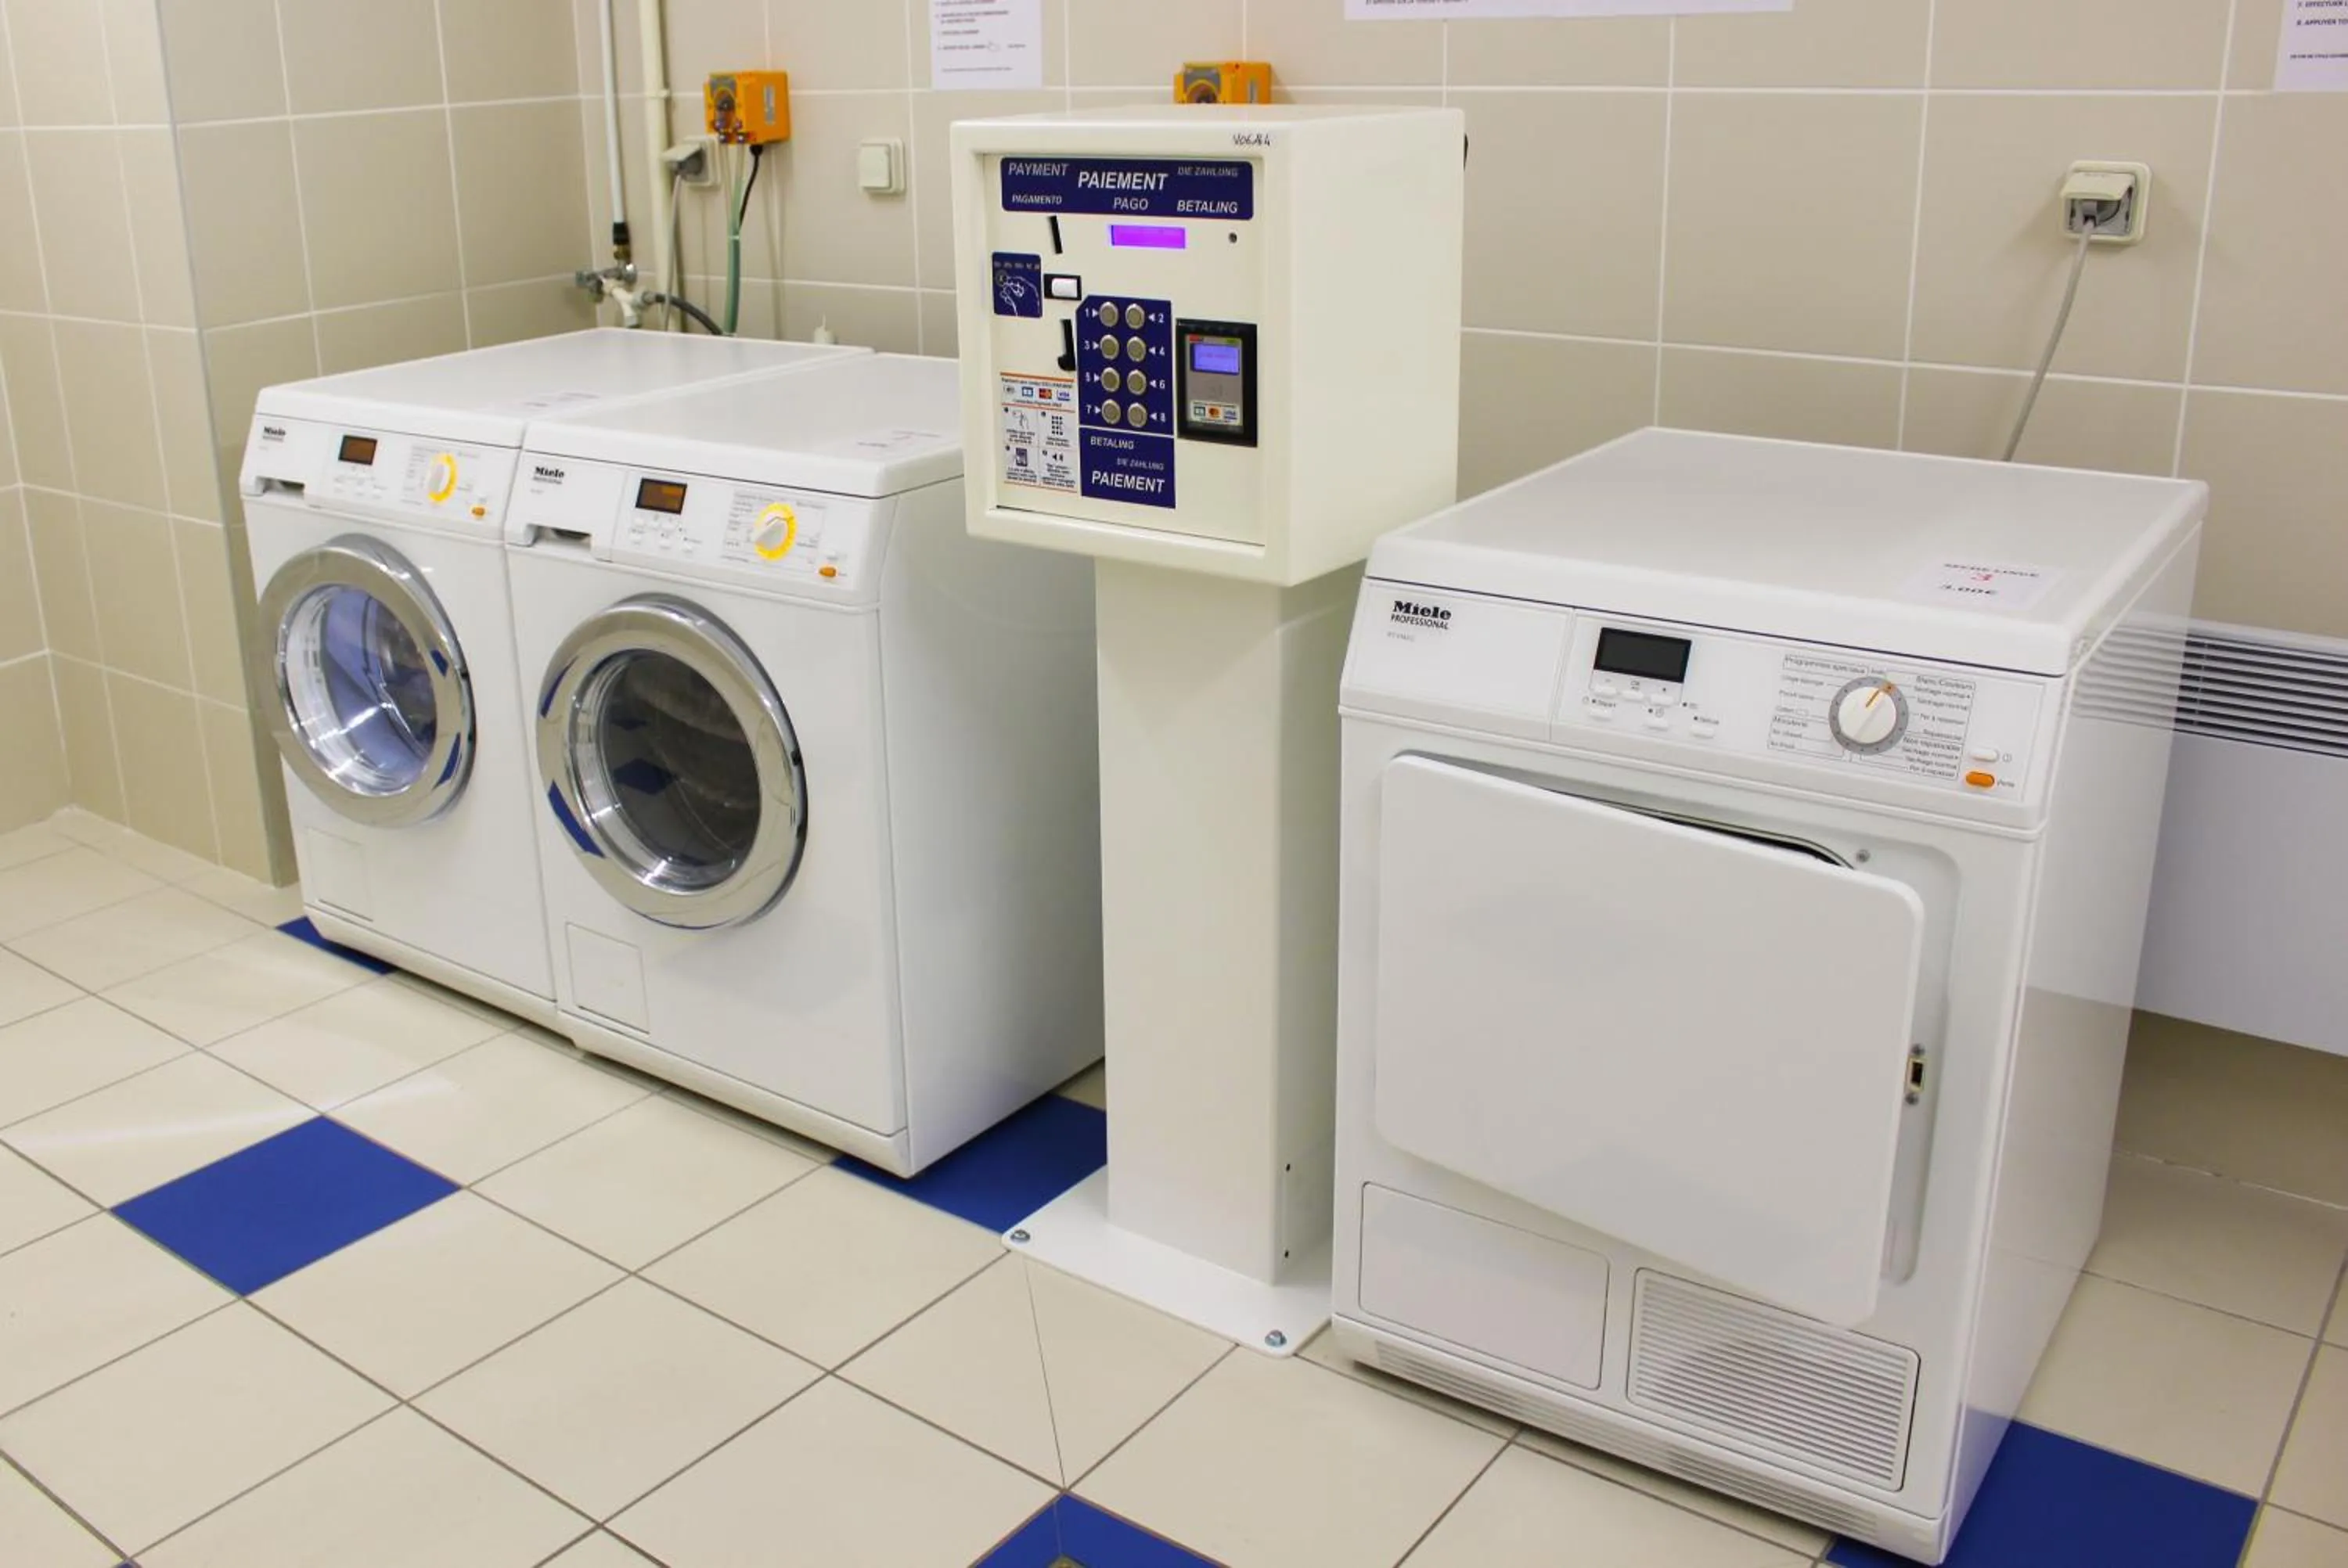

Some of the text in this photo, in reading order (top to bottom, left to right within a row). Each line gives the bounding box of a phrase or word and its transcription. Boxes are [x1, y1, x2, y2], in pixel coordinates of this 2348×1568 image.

[1008, 162, 1069, 176] PAYMENT
[1177, 166, 1239, 178] DIE ZAHLUNG
[1078, 171, 1169, 191] PAIEMENT
[1012, 194, 1063, 205] PAGAMENTO
[1113, 197, 1149, 211] PAGO
[1176, 200, 1238, 214] BETALING
[1085, 307, 1089, 318] 1
[1158, 313, 1165, 323] 2
[1084, 339, 1090, 351] 3
[1159, 346, 1165, 356] 4
[1159, 379, 1165, 390] 6
[1086, 404, 1092, 414] 7
[1090, 436, 1134, 450] BETALING
[535, 466, 564, 478] Miele
[1092, 470, 1165, 493] PAIEMENT
[1393, 600, 1452, 620] Miele
[1390, 613, 1449, 630] PROFESSIONAL
